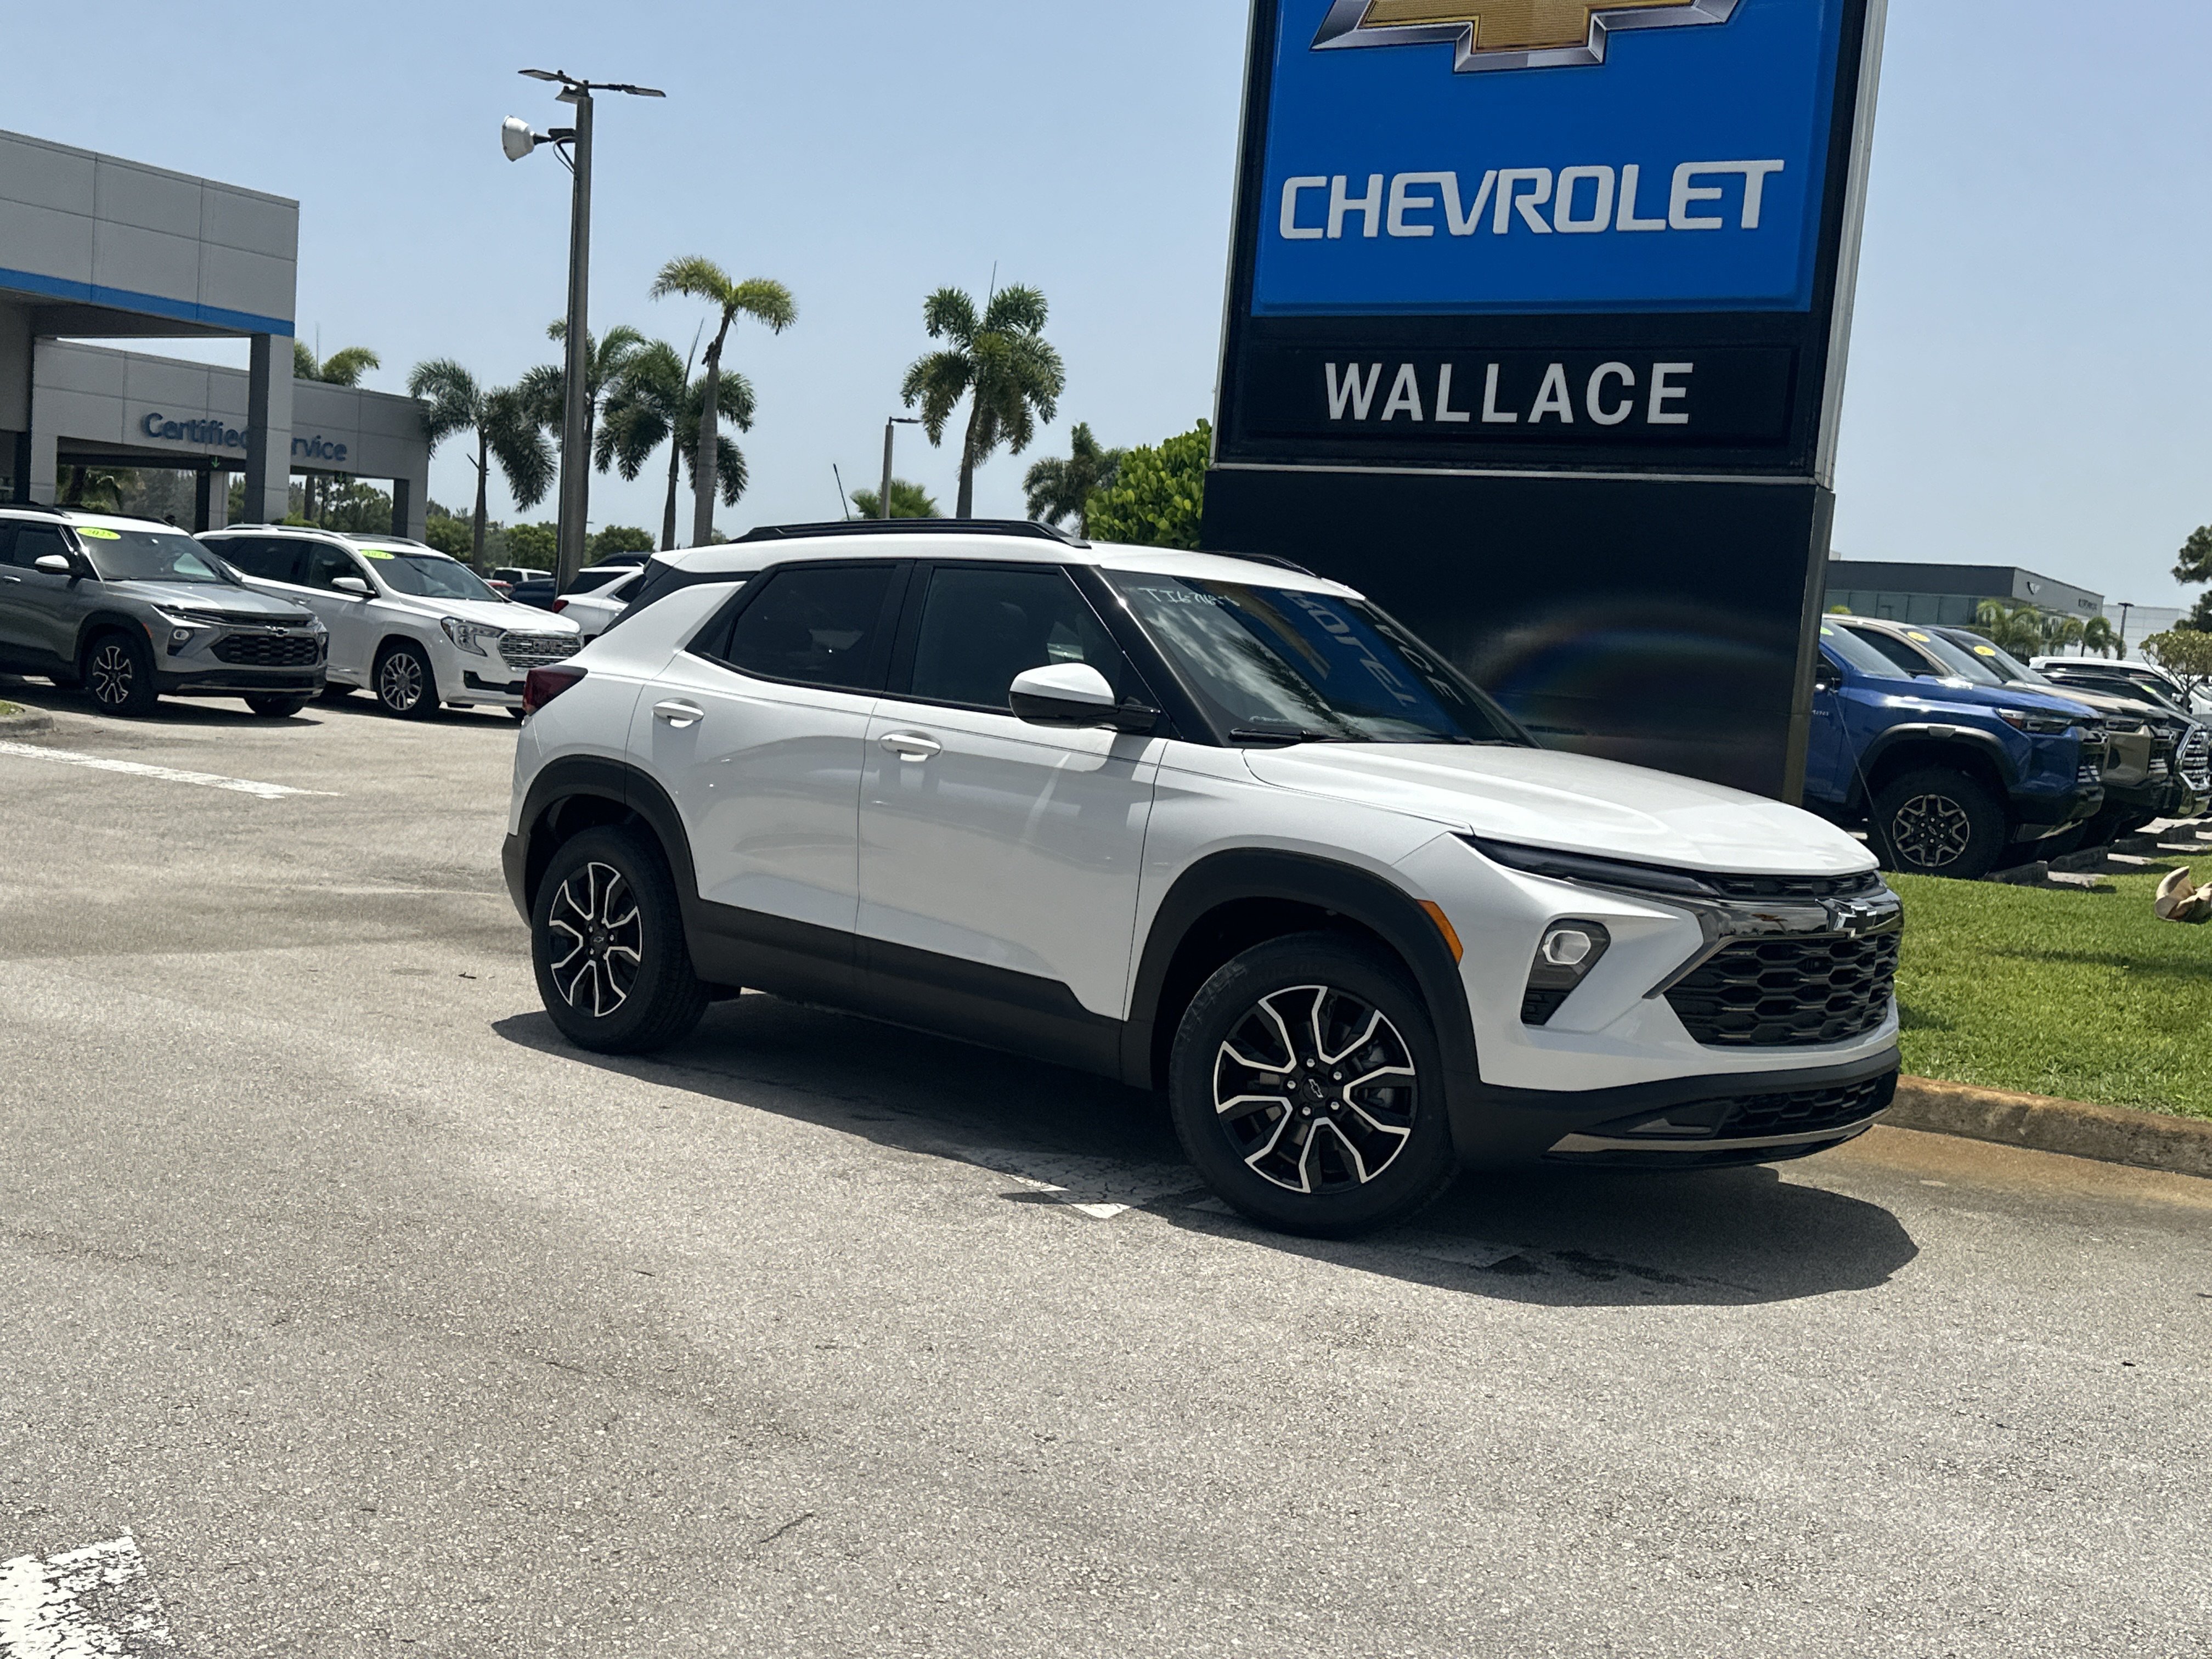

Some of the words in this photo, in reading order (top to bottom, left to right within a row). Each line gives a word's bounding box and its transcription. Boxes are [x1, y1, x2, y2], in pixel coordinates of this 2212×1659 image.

[1280, 160, 1784, 238] CHEVROLET
[1325, 363, 1693, 424] WALLACE
[291, 435, 348, 461] rvice
